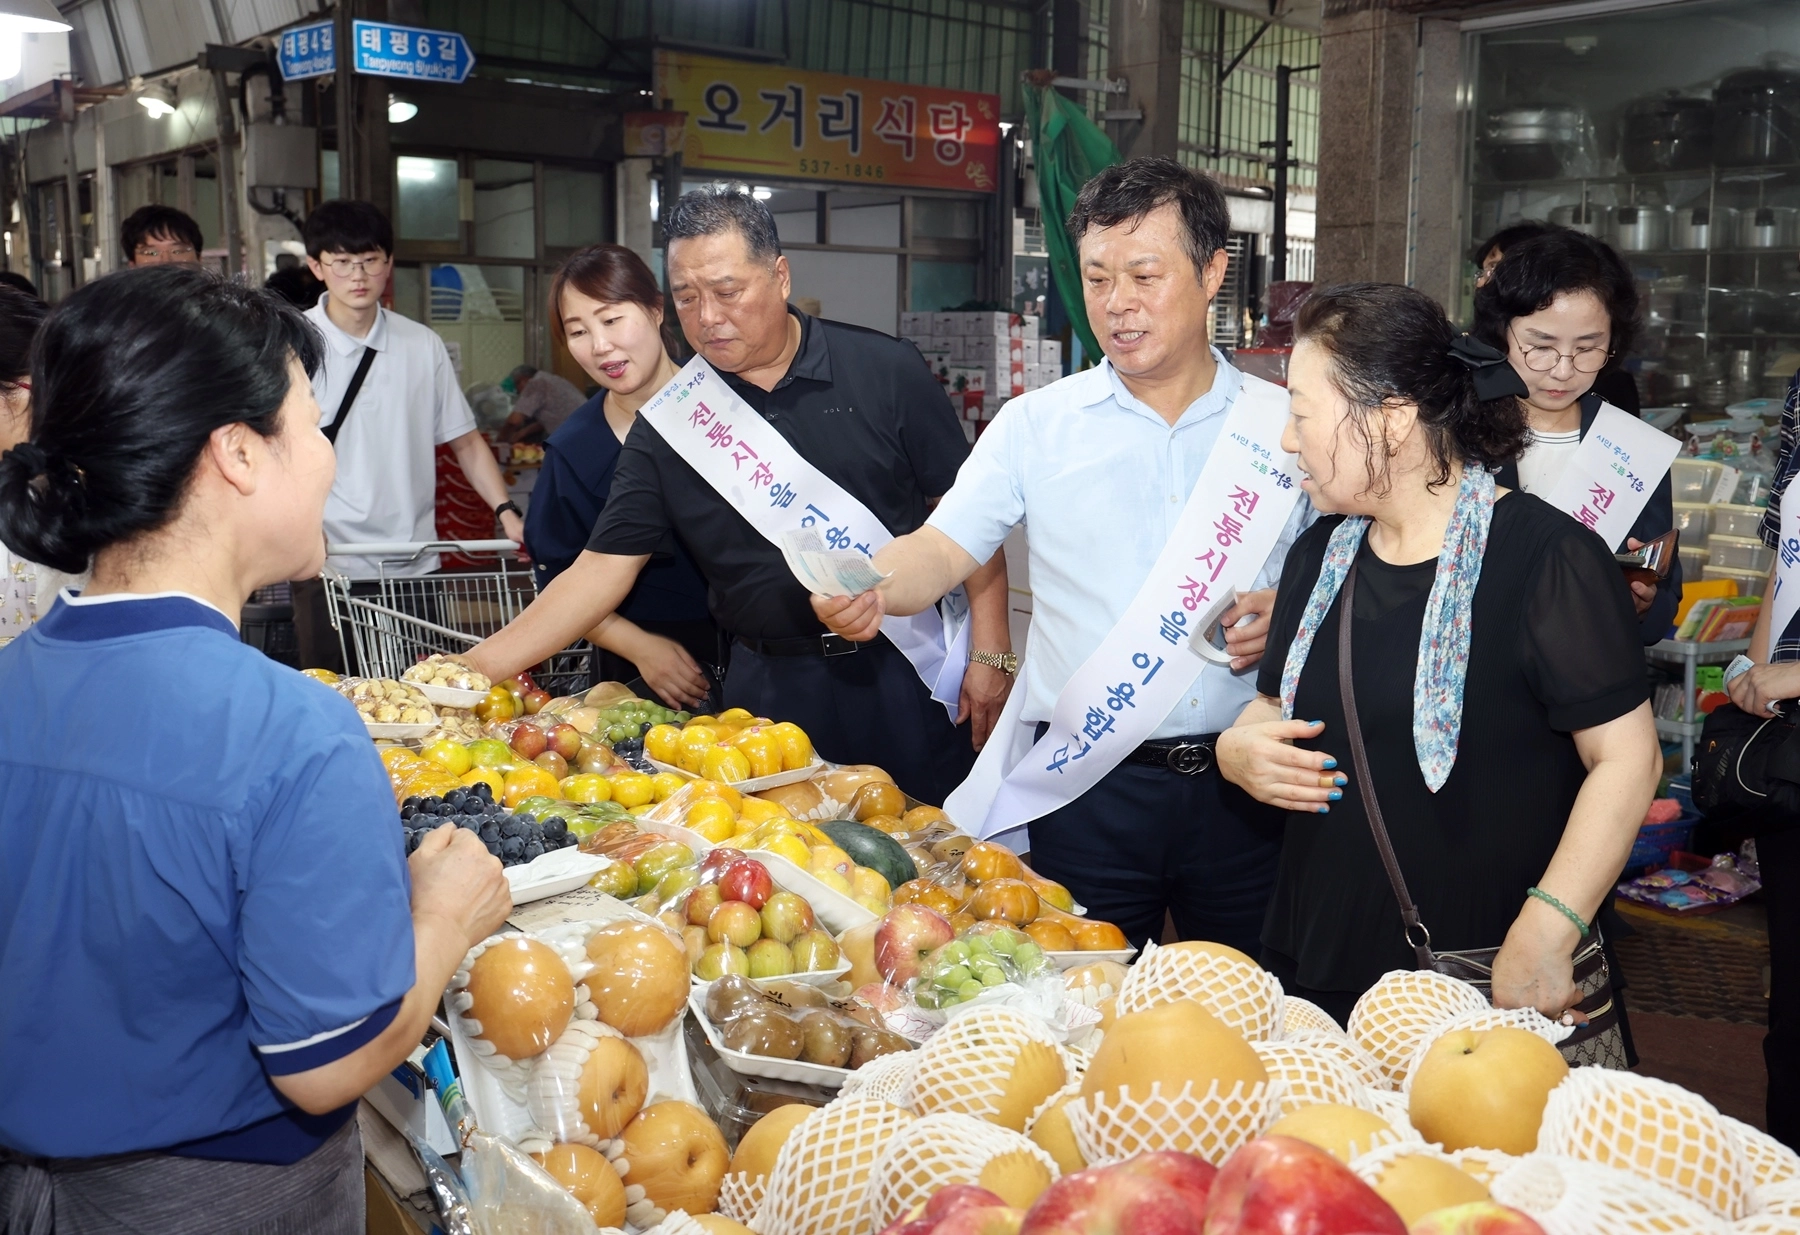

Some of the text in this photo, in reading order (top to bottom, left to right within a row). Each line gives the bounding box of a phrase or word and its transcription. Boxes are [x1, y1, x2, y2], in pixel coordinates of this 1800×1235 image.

[362, 53, 415, 75] Taepyeong
[800, 158, 884, 178] 537-1846
[688, 401, 797, 508] 전통시장을
[1230, 432, 1272, 461] 시민 중심,
[1596, 435, 1630, 465] 시민 중심,
[1251, 460, 1293, 489] 으뜸 정읍
[1610, 462, 1645, 493] 으뜸 정읍
[1160, 484, 1260, 646] 전통시장을
